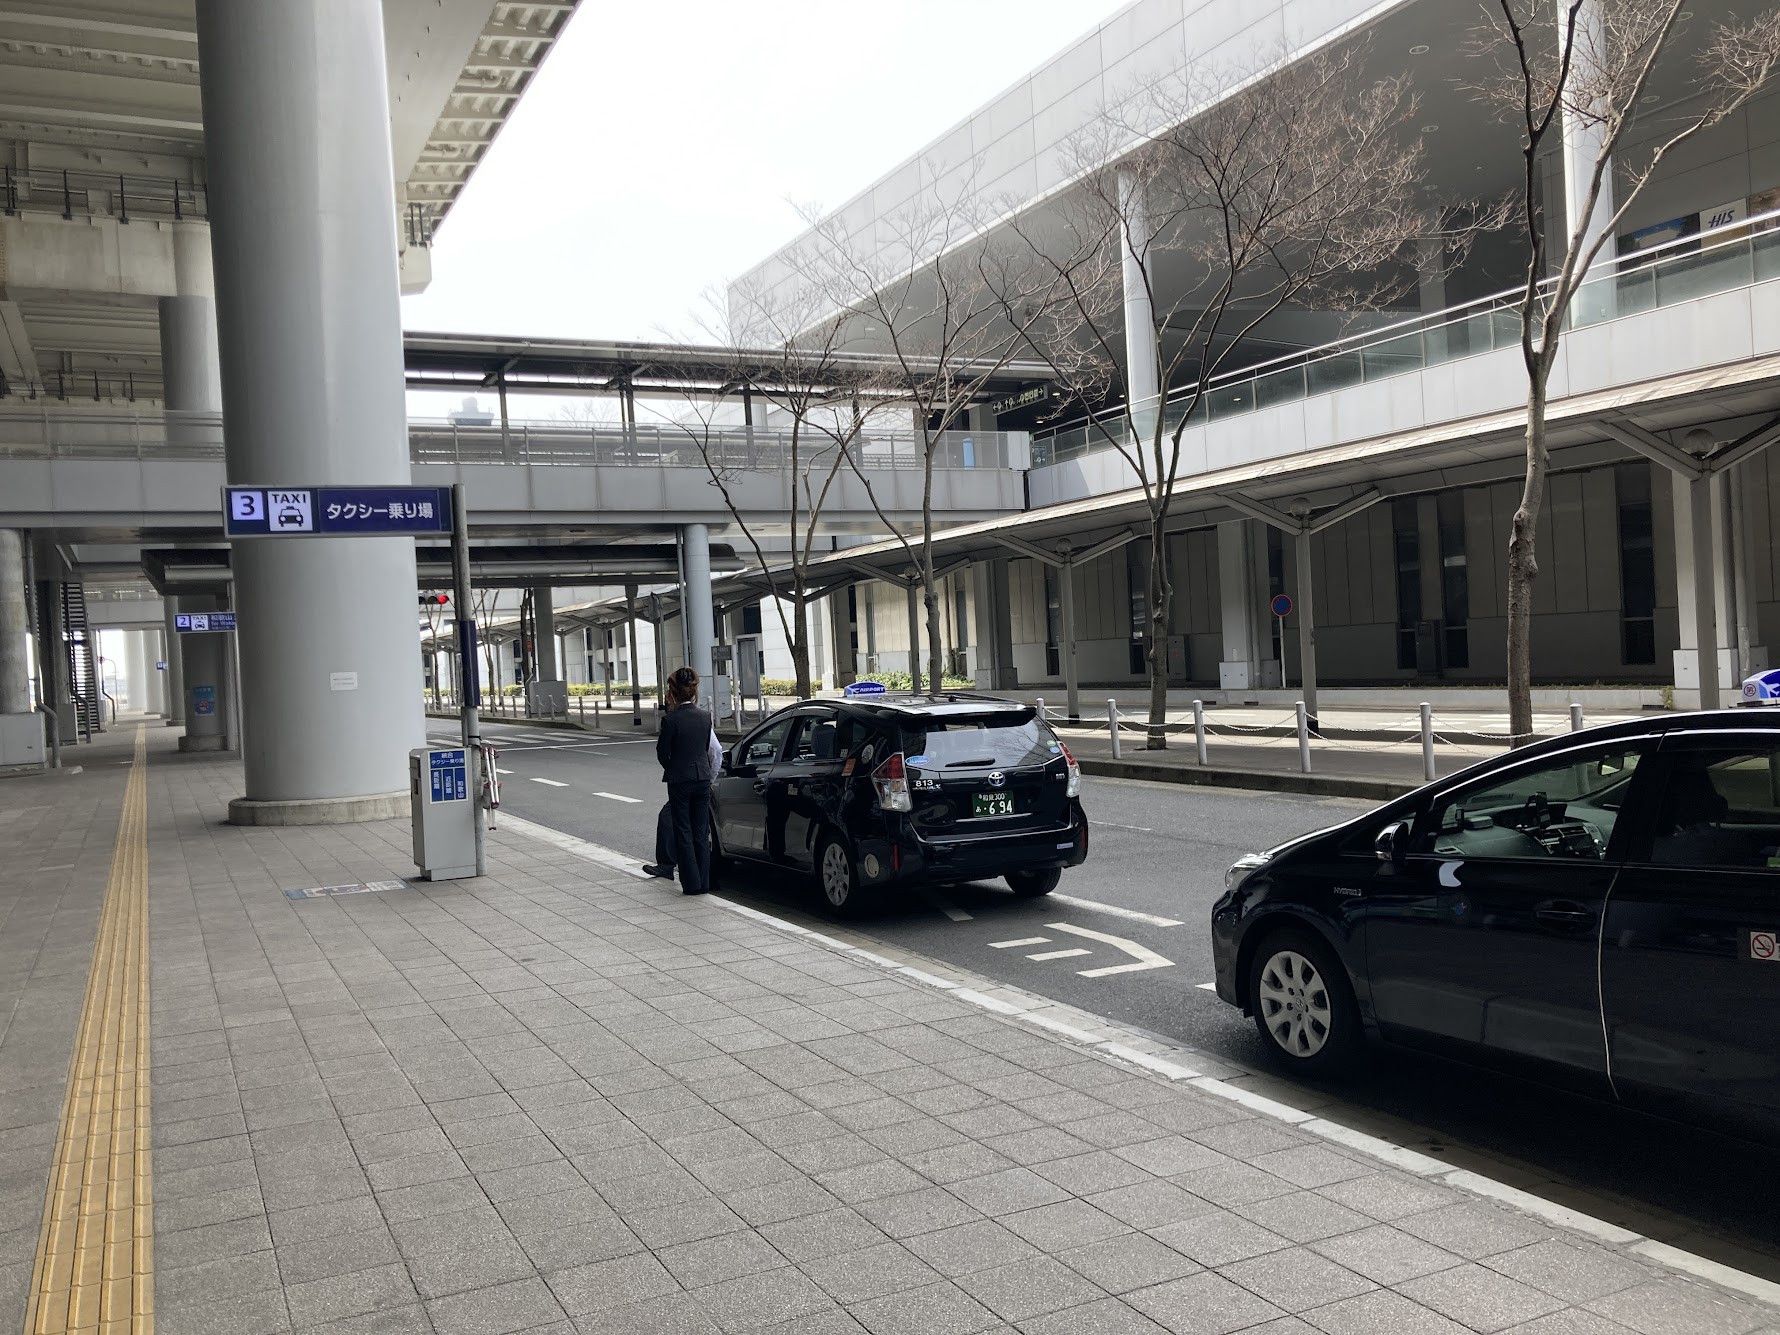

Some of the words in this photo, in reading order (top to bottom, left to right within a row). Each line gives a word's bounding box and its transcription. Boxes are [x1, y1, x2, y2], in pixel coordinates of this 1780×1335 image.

[1708, 209, 1735, 228] HIS
[240, 495, 255, 516] 3
[271, 493, 306, 504] TAXI
[326, 502, 433, 520] タクシー乗り場
[180, 617, 187, 626] 2
[915, 779, 934, 787] 813
